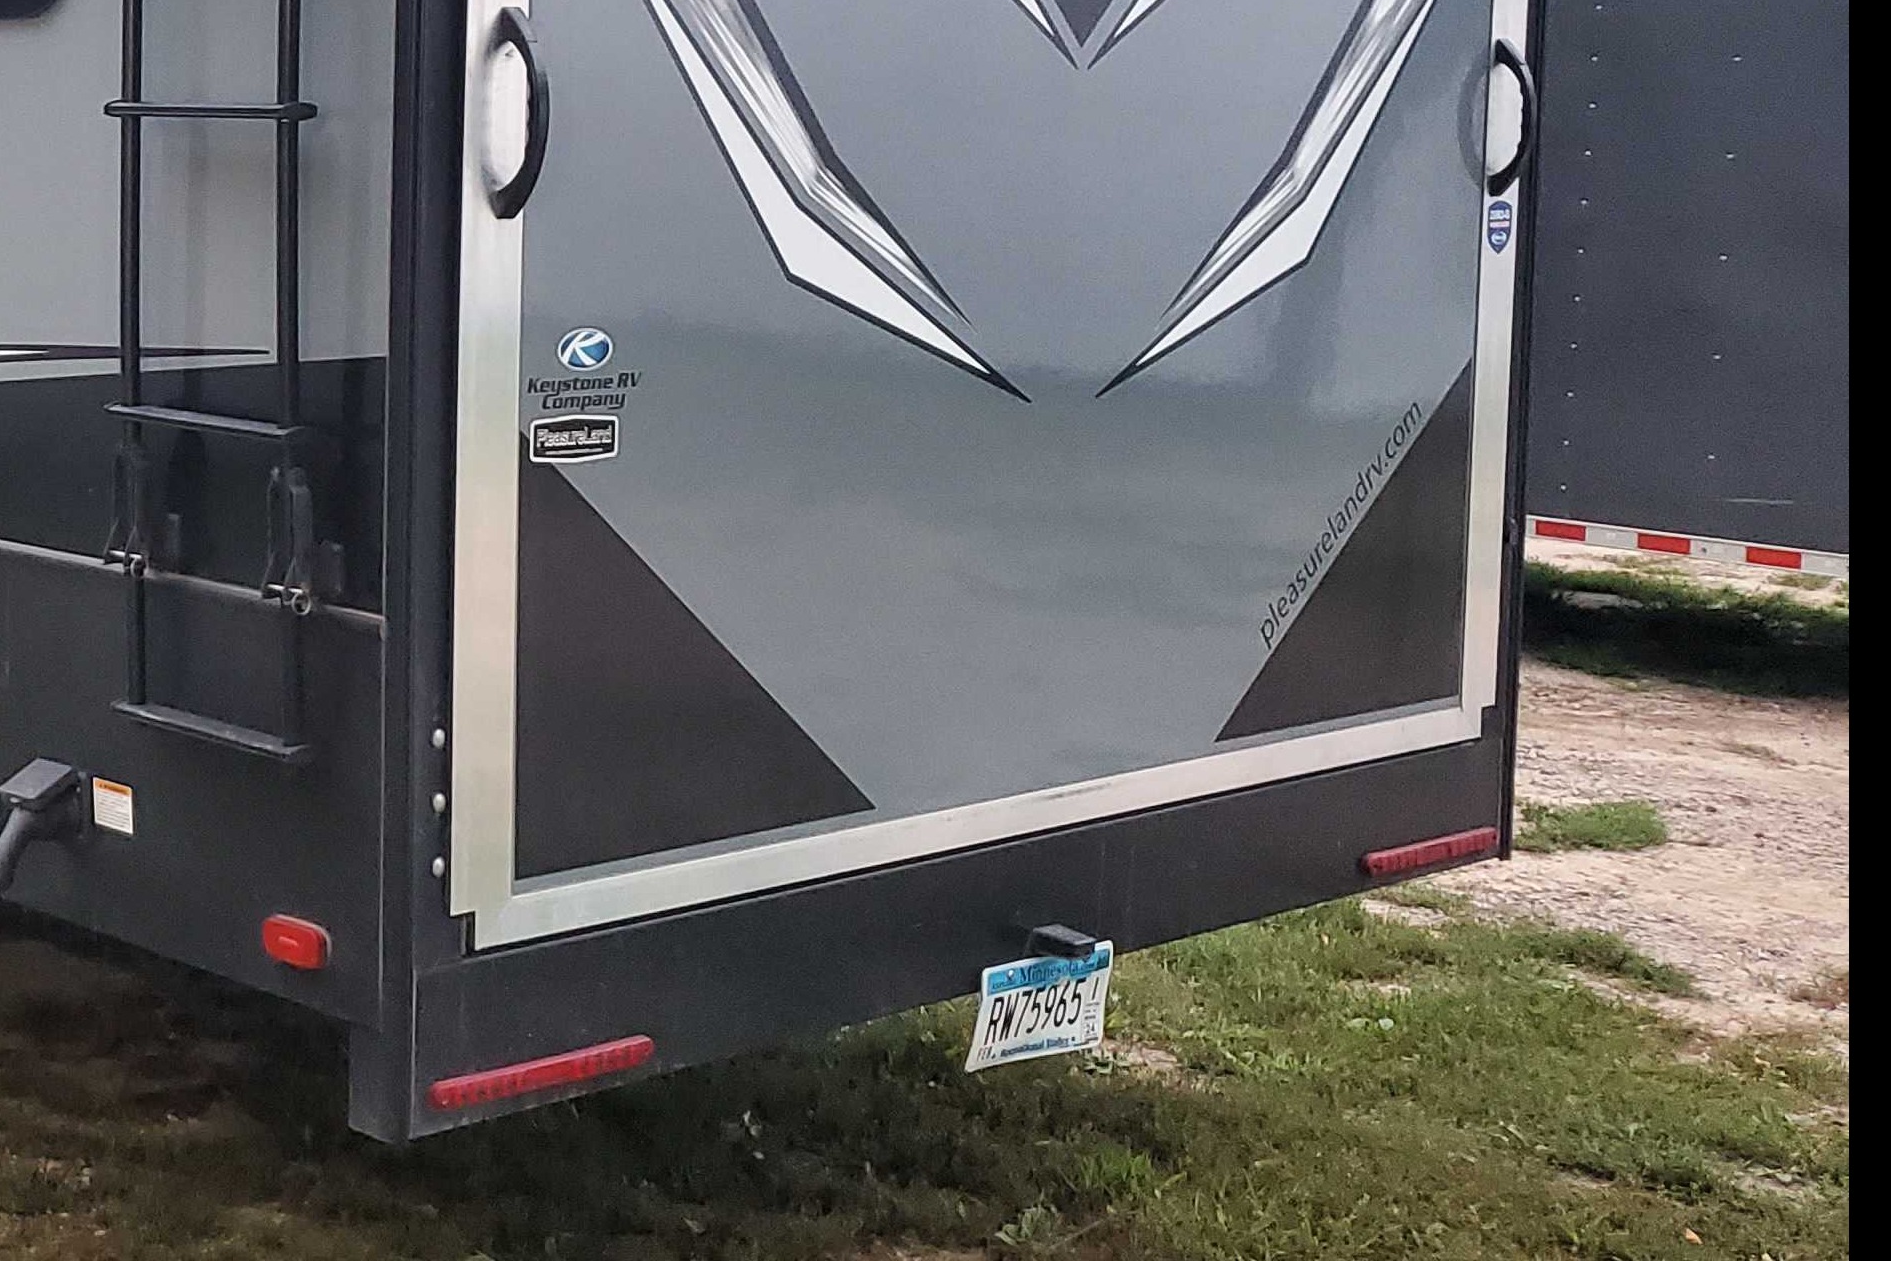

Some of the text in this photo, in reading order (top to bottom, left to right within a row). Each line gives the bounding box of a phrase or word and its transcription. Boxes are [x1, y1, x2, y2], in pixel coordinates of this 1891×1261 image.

[527, 372, 642, 396] Keystone RV
[542, 393, 626, 410] Company
[1260, 402, 1423, 650] pleasurelandrv.com
[984, 977, 1087, 1046] RW75965
